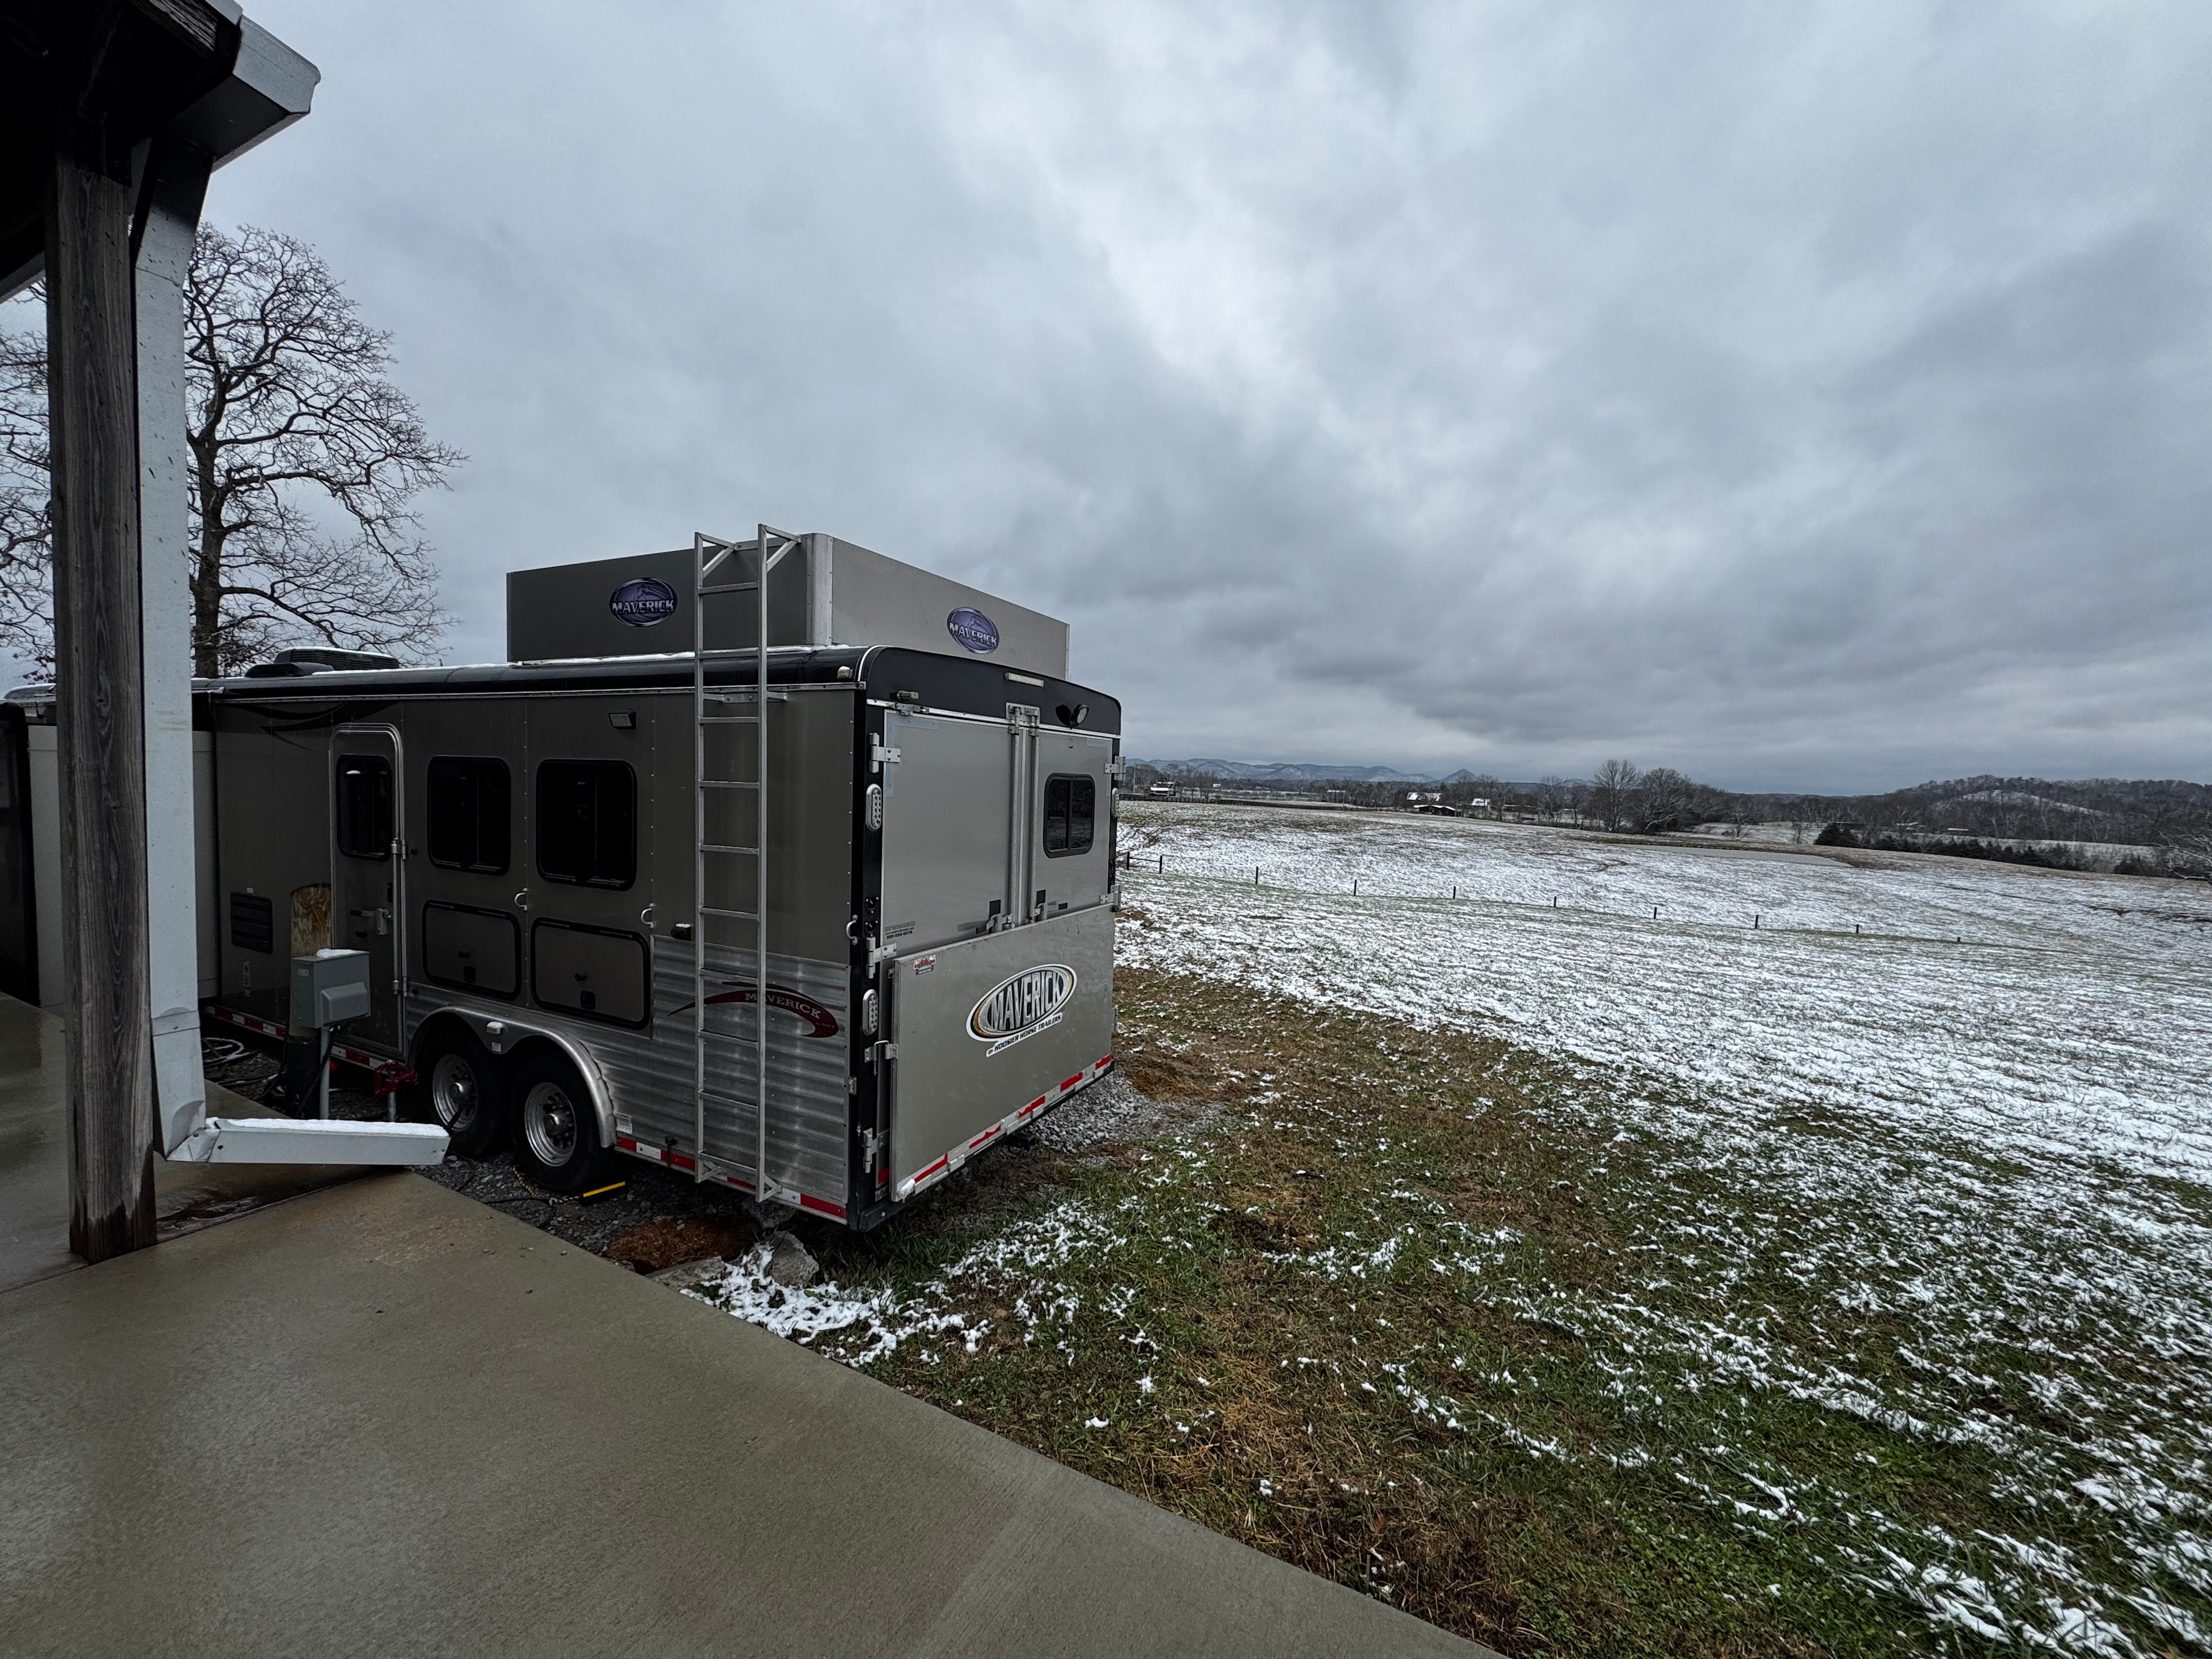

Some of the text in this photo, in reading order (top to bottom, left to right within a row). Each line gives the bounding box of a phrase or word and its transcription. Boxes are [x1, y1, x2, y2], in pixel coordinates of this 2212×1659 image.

[612, 600, 674, 614] MAVERICK
[949, 622, 997, 647] MAVERICK
[990, 971, 1062, 1031] MAVERICK
[994, 1035, 1019, 1052] HOOSIER
[1020, 1027, 1037, 1039] HORSE
[1038, 1014, 1061, 1031] TRAILERS
